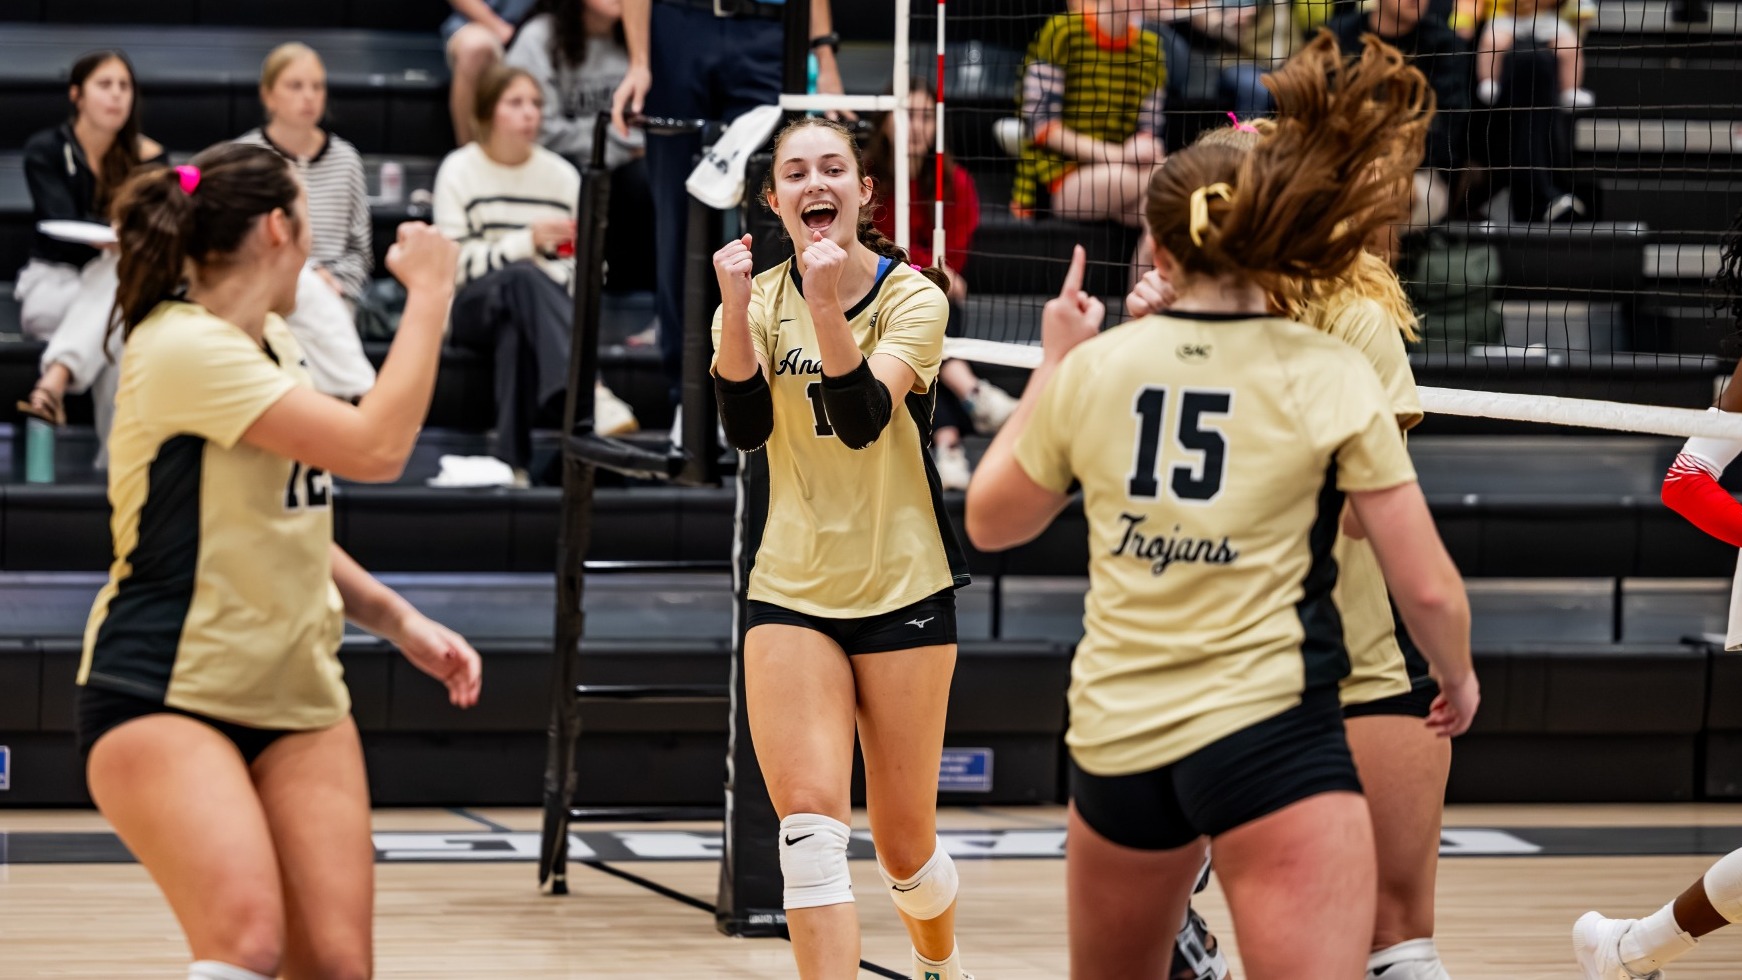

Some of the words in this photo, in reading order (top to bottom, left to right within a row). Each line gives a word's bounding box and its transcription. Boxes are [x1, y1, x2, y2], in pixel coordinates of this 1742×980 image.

[1127, 385, 1233, 503] 15
[284, 459, 329, 509] 12
[1111, 511, 1239, 576] Trojans
